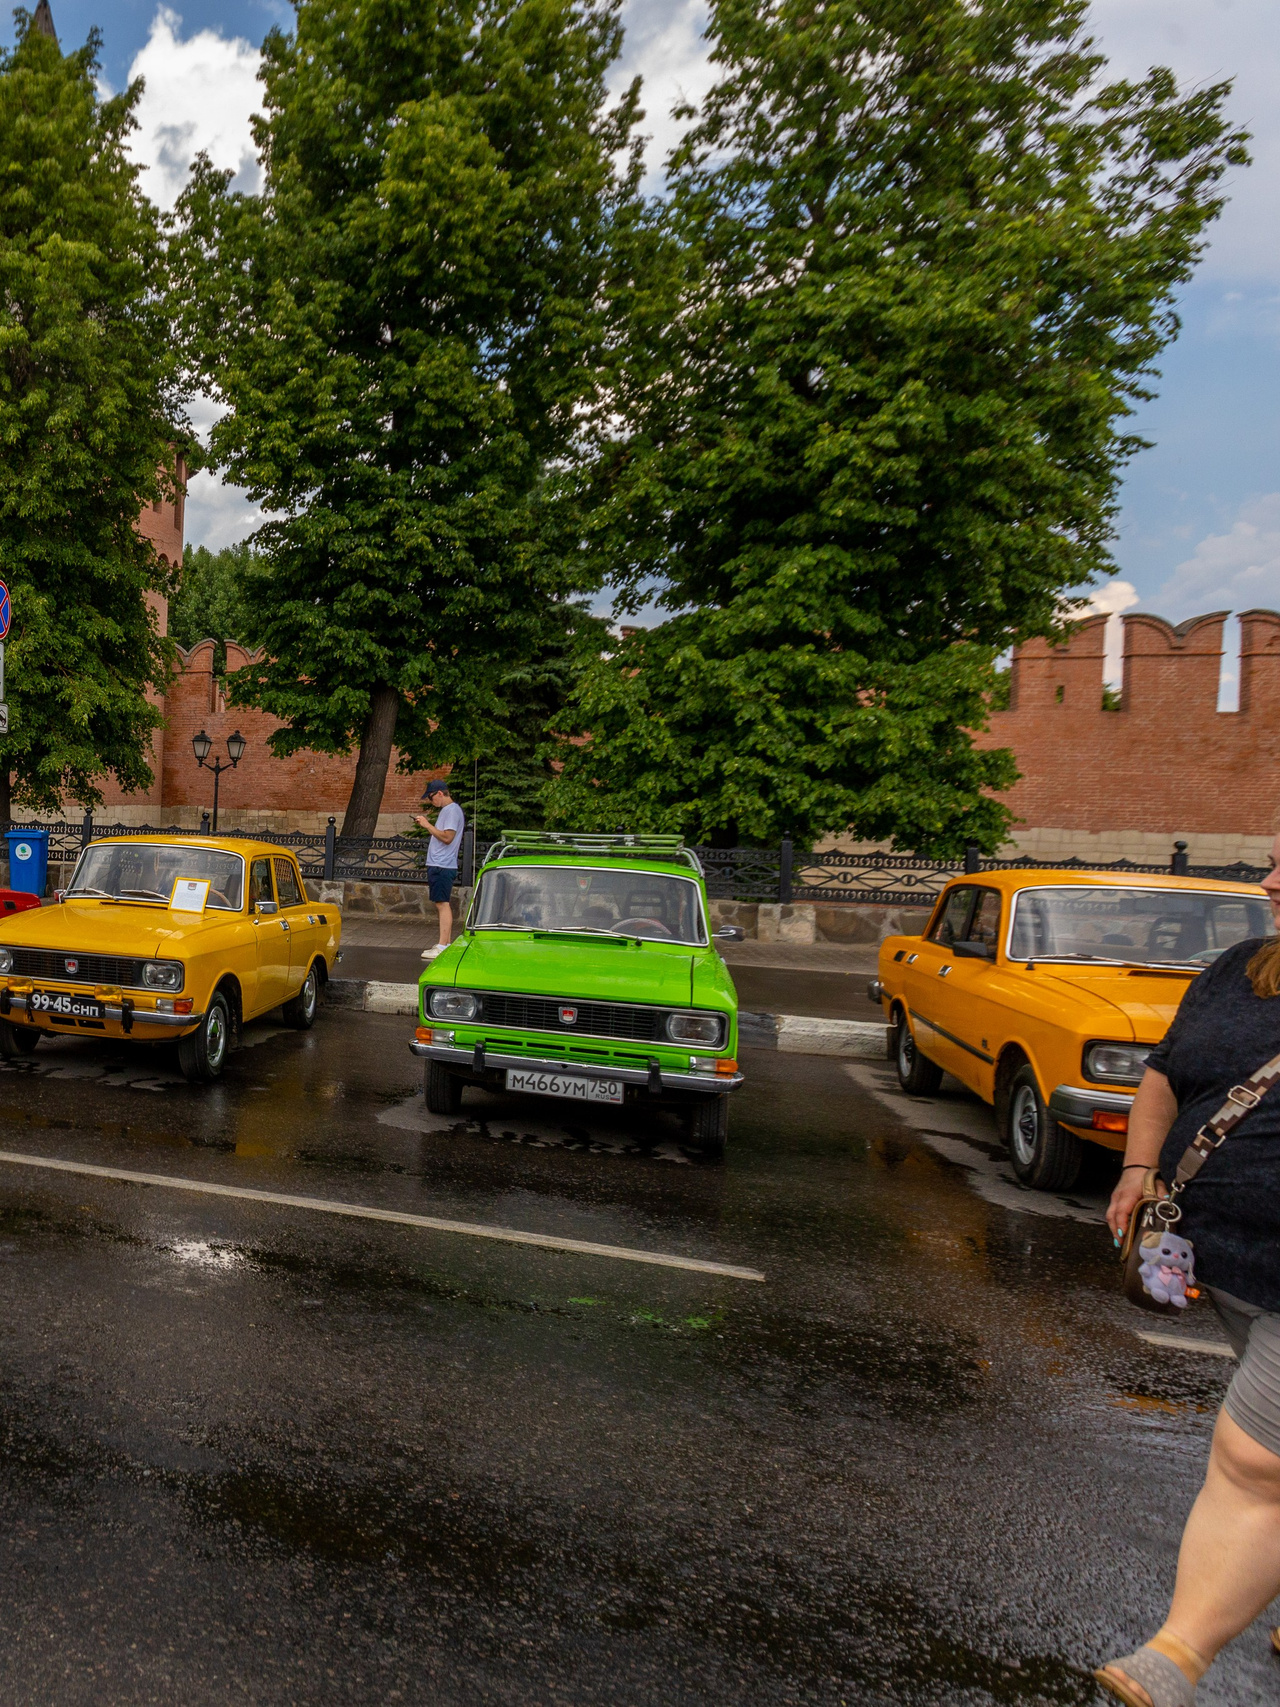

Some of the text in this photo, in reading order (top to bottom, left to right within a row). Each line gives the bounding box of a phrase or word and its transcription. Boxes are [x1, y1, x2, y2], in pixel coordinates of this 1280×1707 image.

[512, 1073, 618, 1097] М466УМ 750
[595, 1093, 610, 1101] RUS
